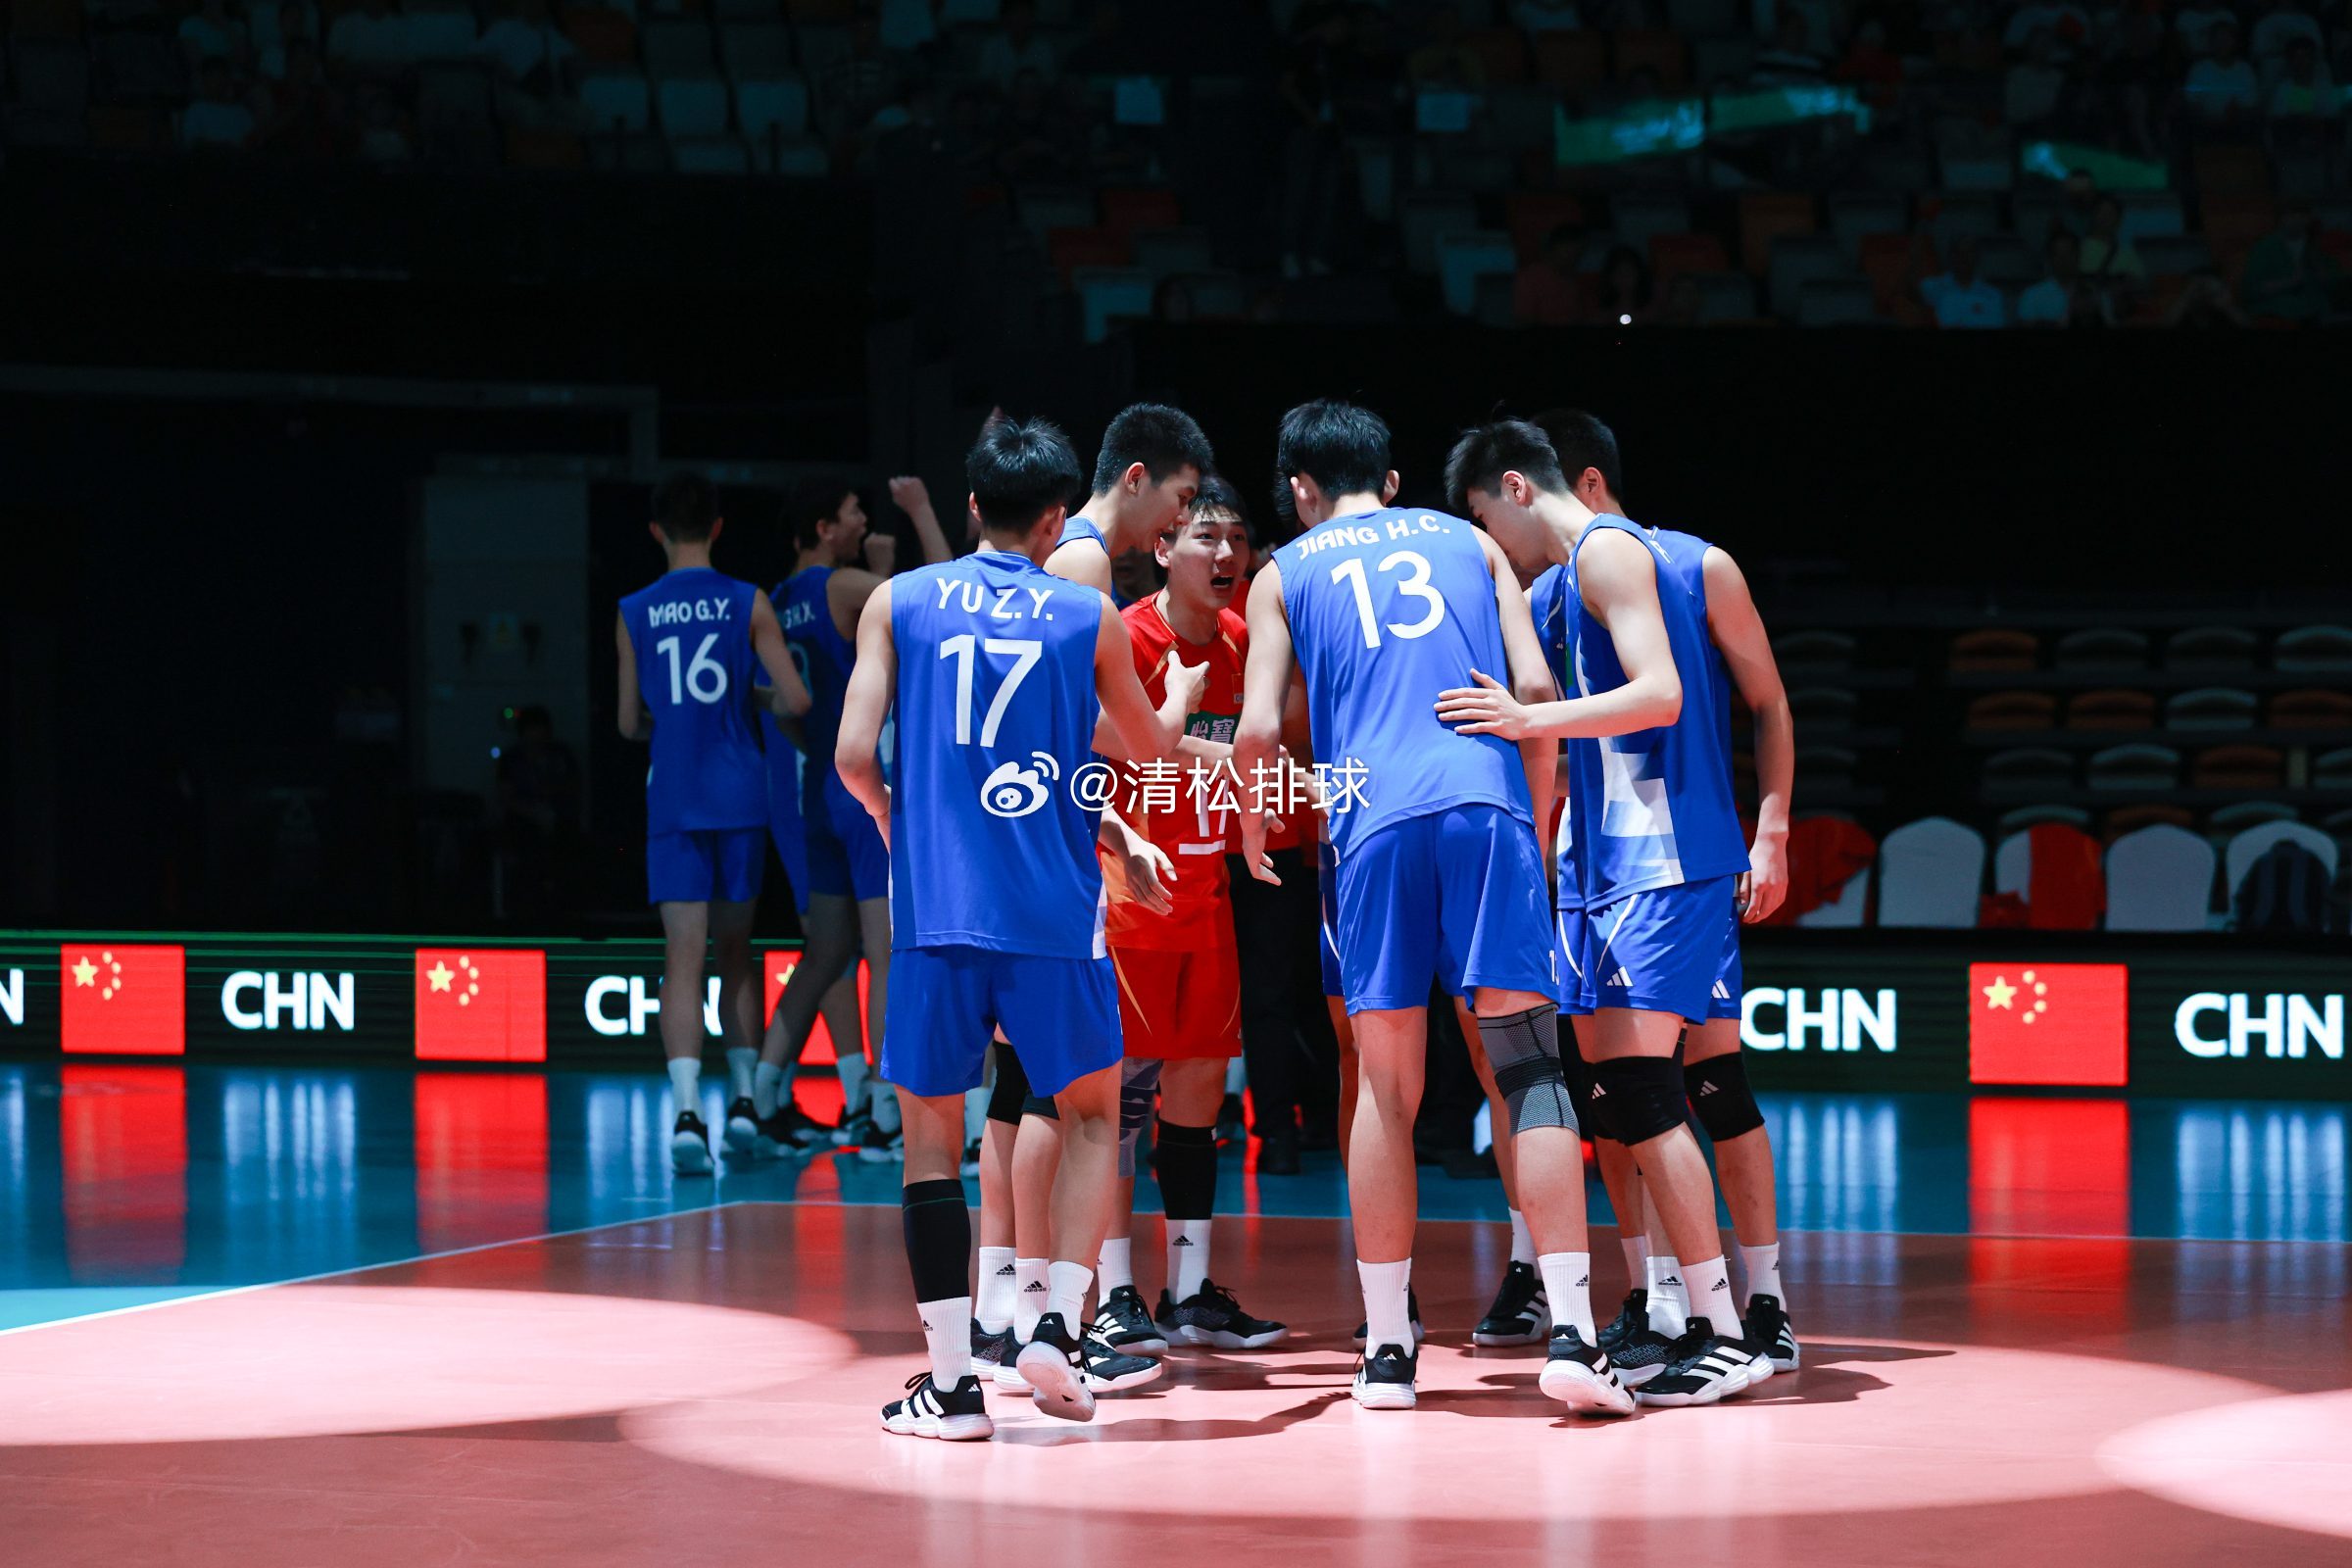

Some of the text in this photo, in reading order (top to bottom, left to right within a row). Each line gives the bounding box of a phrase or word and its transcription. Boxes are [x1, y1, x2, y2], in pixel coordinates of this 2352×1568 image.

[1296, 514, 1450, 561] JIANG H.C.
[648, 597, 730, 628] MAO G.Y.
[936, 577, 1054, 621] YU Z.Y.
[1330, 550, 1446, 650] 13
[657, 633, 727, 705] 16
[939, 634, 1042, 748] 17
[221, 970, 354, 1030] CHN
[1740, 987, 1896, 1052] CHN
[2175, 992, 2343, 1058] CHN
